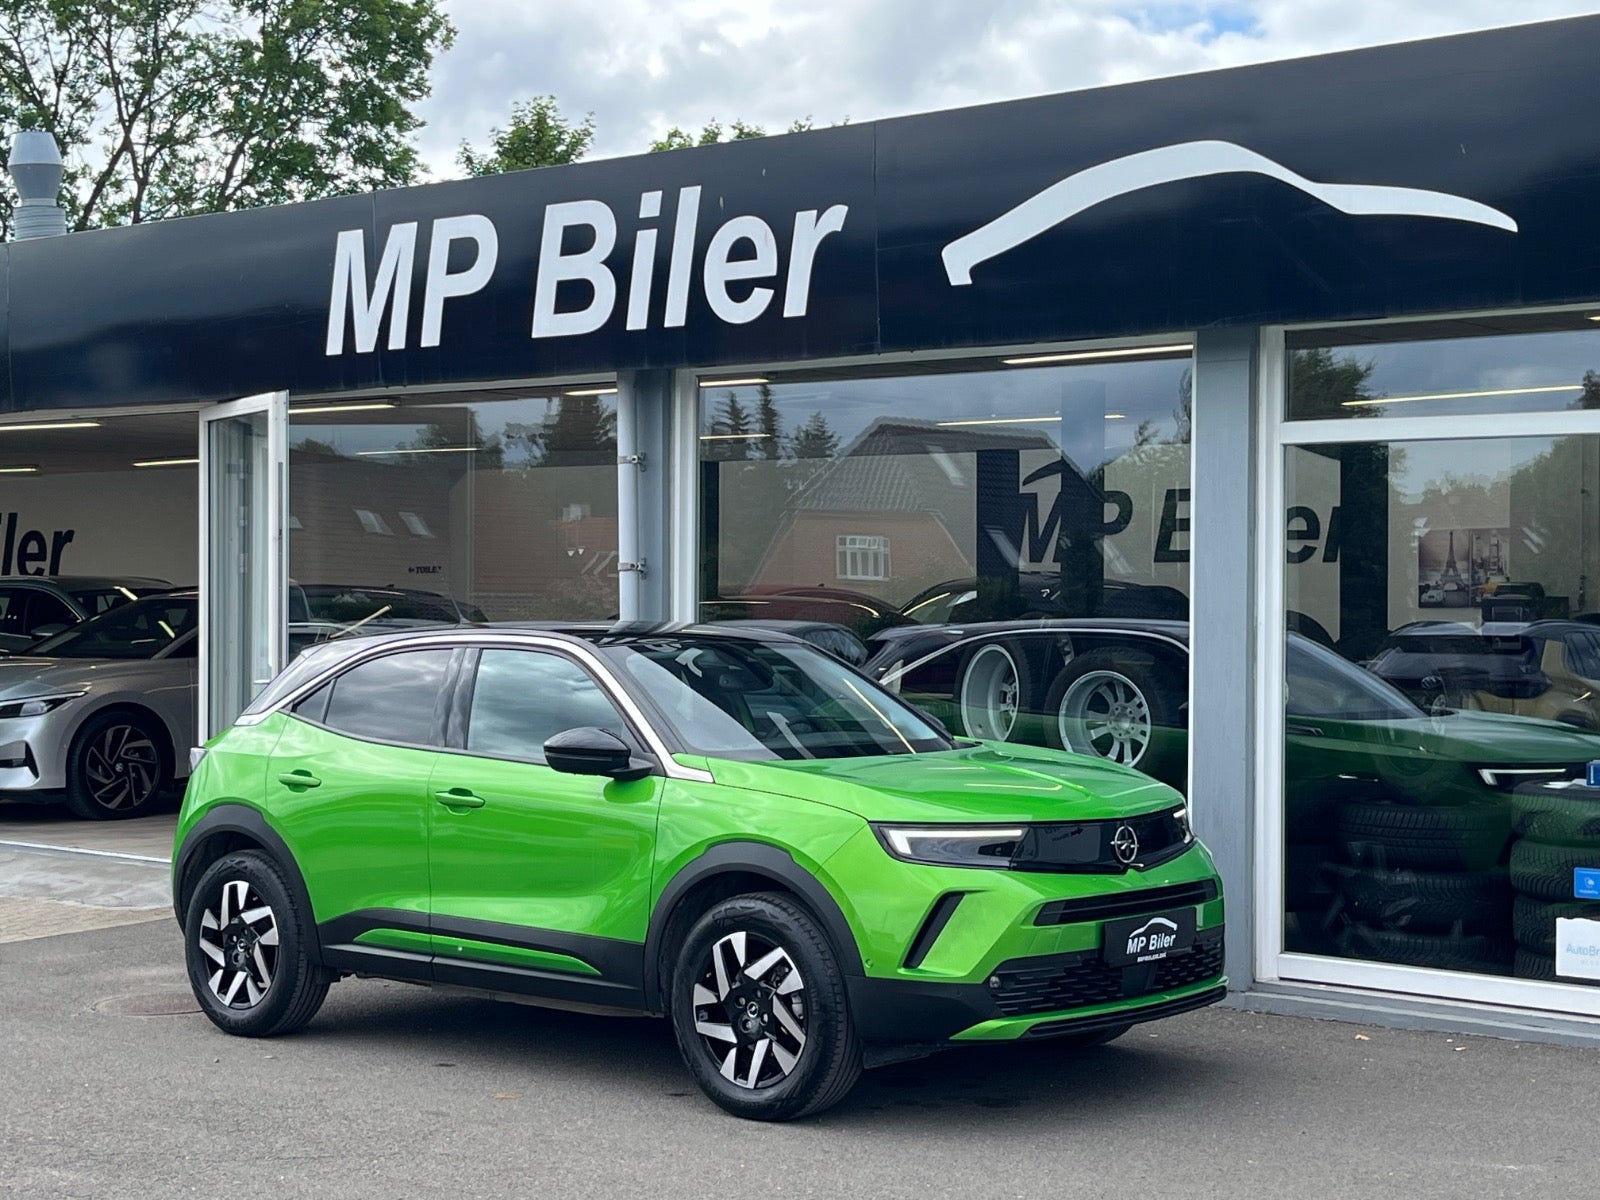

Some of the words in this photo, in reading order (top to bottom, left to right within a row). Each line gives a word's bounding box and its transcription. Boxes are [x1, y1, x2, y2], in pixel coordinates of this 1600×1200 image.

[325, 214, 499, 357] MP
[531, 185, 849, 339] Biler
[0, 512, 75, 576] ler
[1126, 936, 1147, 955] MP
[1148, 932, 1176, 950] Biler
